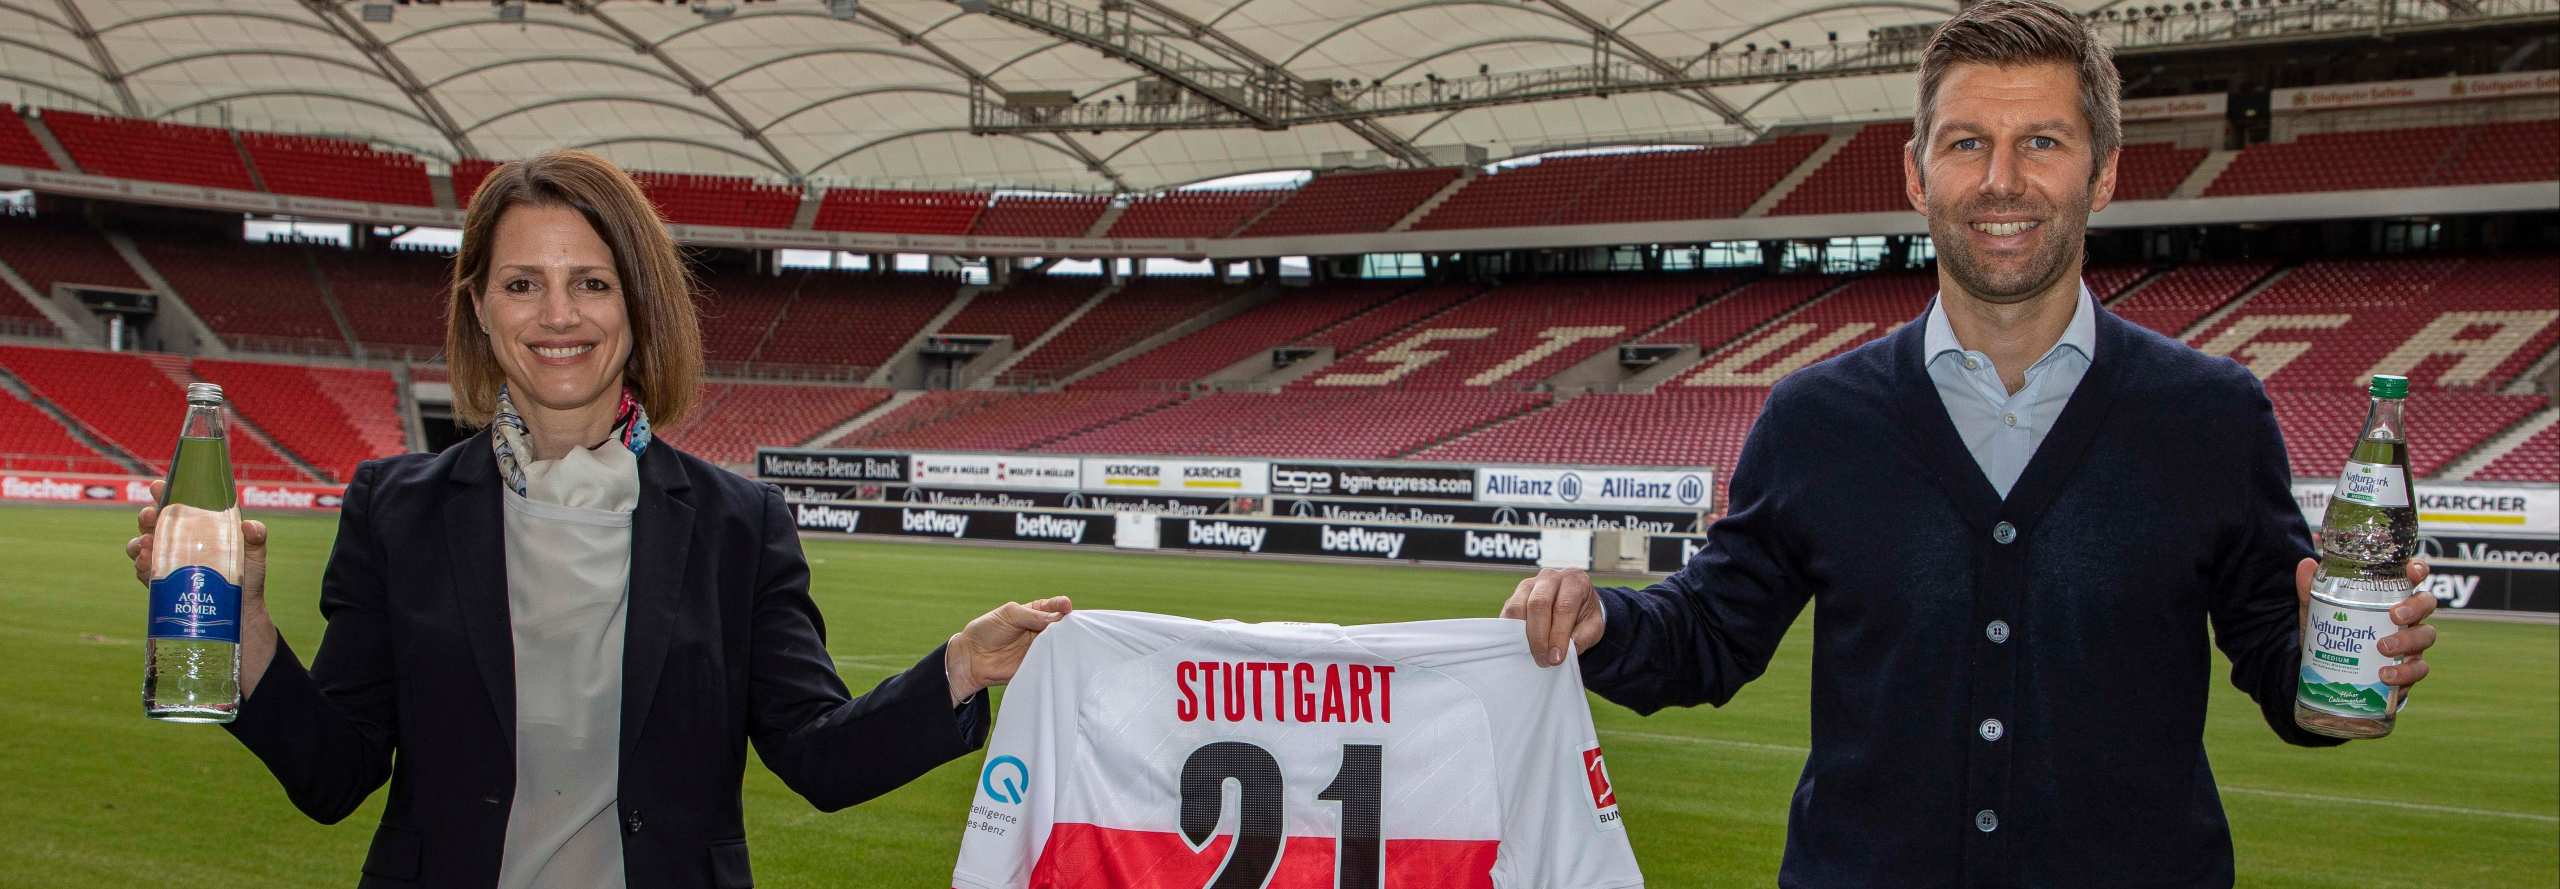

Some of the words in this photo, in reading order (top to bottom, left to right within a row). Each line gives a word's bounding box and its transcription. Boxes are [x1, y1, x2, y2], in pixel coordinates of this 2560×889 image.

[764, 455, 862, 478] Mercedes-Benz
[865, 457, 900, 479] Bank
[2, 476, 82, 499] fischer
[1340, 472, 1472, 495] bgm-express.com
[1486, 474, 1553, 497] Allianz
[1600, 477, 1672, 500] Allianz
[243, 485, 315, 508] fischer
[797, 504, 860, 533] betway
[902, 508, 969, 538] betway
[1015, 512, 1086, 544] betway
[1188, 520, 1266, 552] betway
[1321, 525, 1405, 559] betway
[175, 602, 217, 616] RÖMER
[178, 592, 215, 605] AQUA
[2311, 612, 2377, 641] Naturpark
[2316, 632, 2363, 653] Quelle
[2321, 652, 2350, 664] MEDIUM
[1176, 661, 1396, 724] STUTTGART
[970, 804, 1018, 825] telligence
[1179, 740, 1383, 889] 21
[967, 819, 1006, 836] es-Benz
